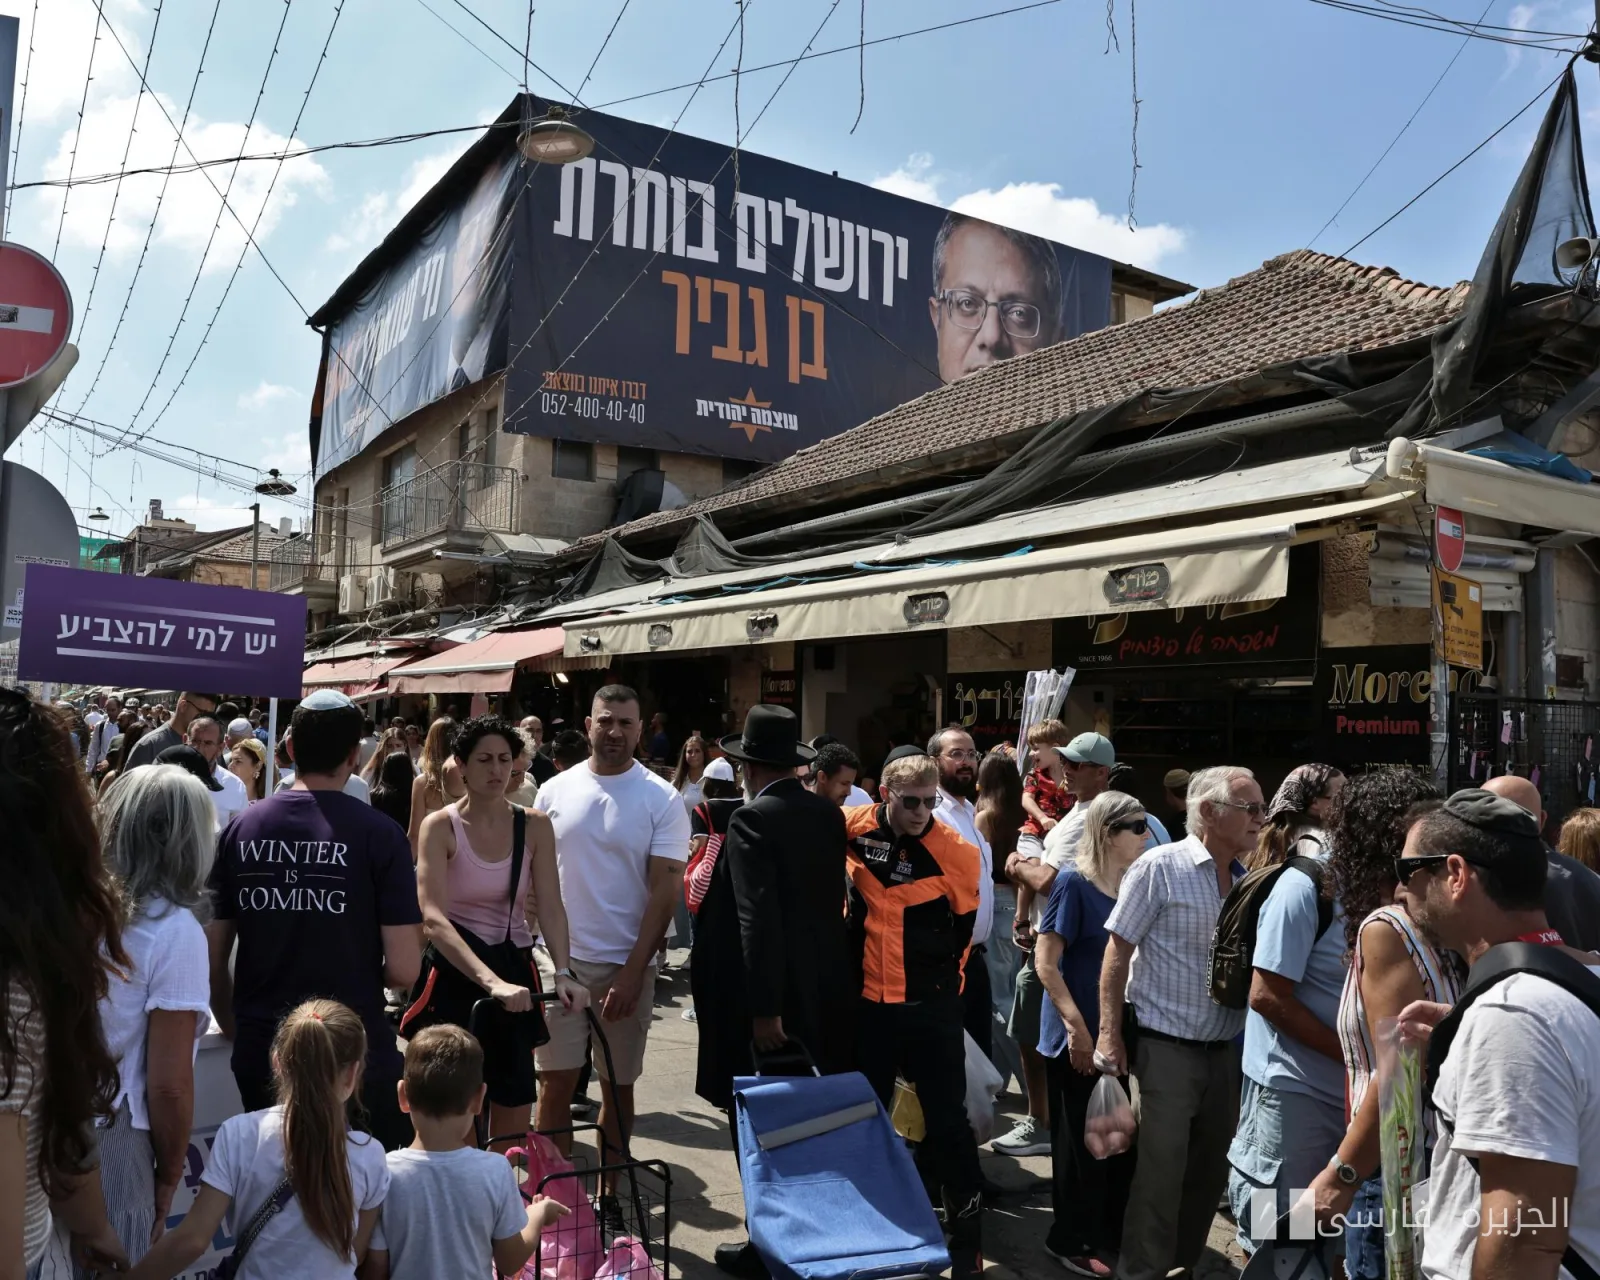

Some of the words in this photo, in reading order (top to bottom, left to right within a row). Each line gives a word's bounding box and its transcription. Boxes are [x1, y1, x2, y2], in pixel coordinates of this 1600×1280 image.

[553, 157, 719, 264] בוחרת
[736, 191, 909, 307] ירושלים
[661, 270, 768, 368] גביר
[785, 294, 828, 384] בן
[588, 376, 619, 397] איתנו
[621, 380, 647, 400] דברו
[541, 392, 646, 424] 052-400-40-40
[695, 398, 748, 422] יהודית
[750, 407, 798, 431] עוצמה
[56, 613, 176, 647] להצביע
[187, 625, 235, 652] למי
[244, 631, 277, 656] יש
[1185, 626, 1204, 655] של
[1211, 624, 1280, 653] משפחה
[1078, 655, 1096, 663] SINCE
[1098, 654, 1113, 662] 1966
[1119, 635, 1180, 661] פיצוחים
[1327, 663, 1484, 704] Moreo
[1336, 715, 1420, 735] Premium
[239, 839, 348, 867] WINTER
[284, 869, 298, 884] IS
[238, 886, 348, 914] COMING
